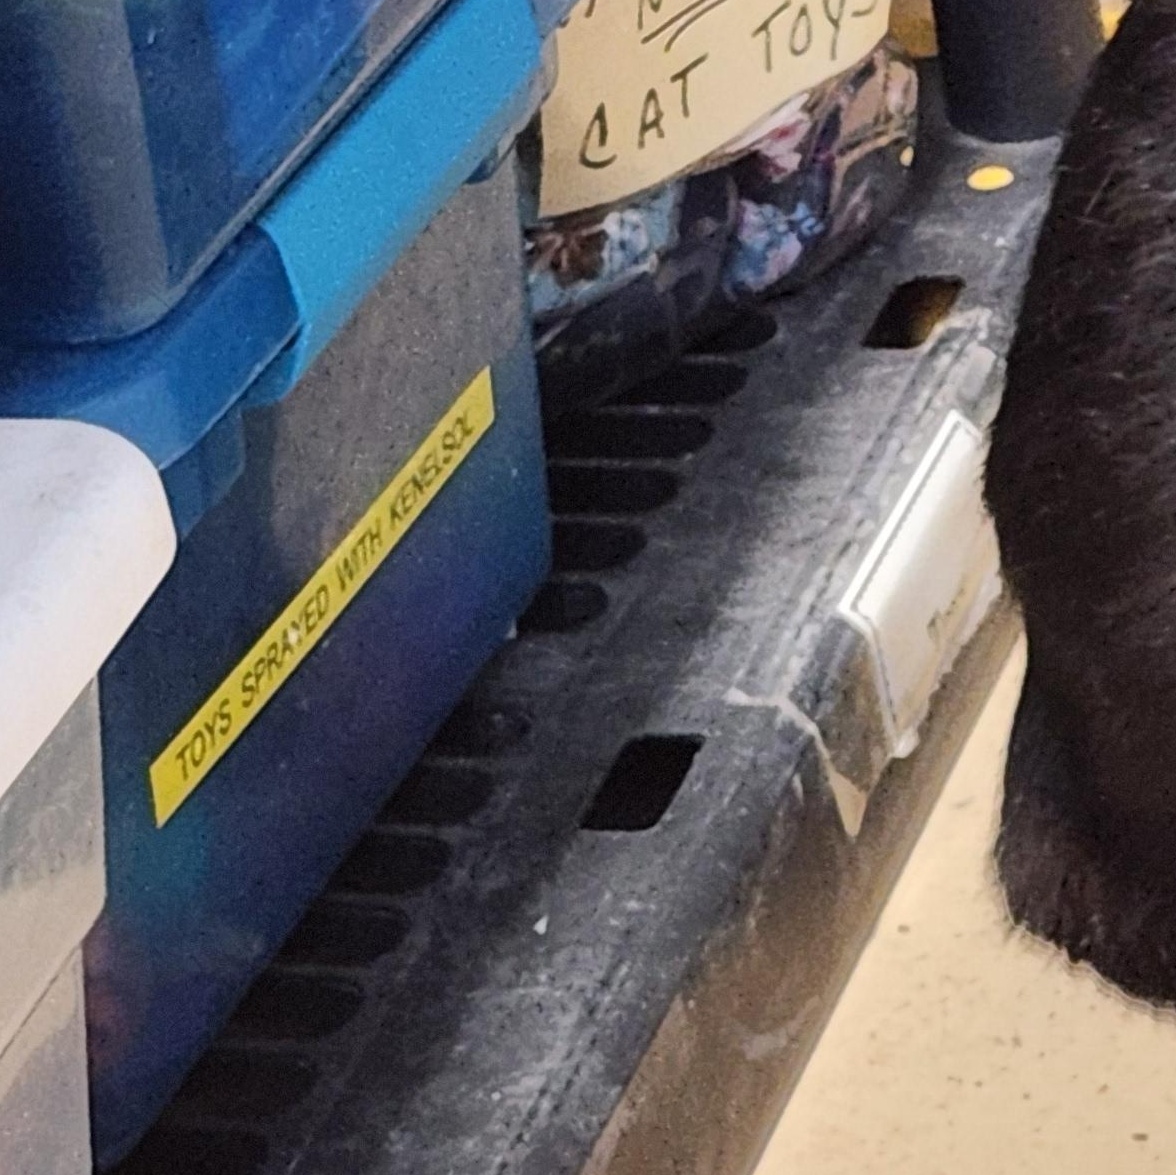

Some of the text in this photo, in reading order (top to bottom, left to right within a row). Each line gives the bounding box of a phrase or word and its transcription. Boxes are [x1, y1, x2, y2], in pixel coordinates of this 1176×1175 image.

[579, 53, 709, 169] CAT
[175, 698, 233, 782] TOYS
[241, 584, 330, 708] SPRAYED
[334, 516, 383, 593] WITH
